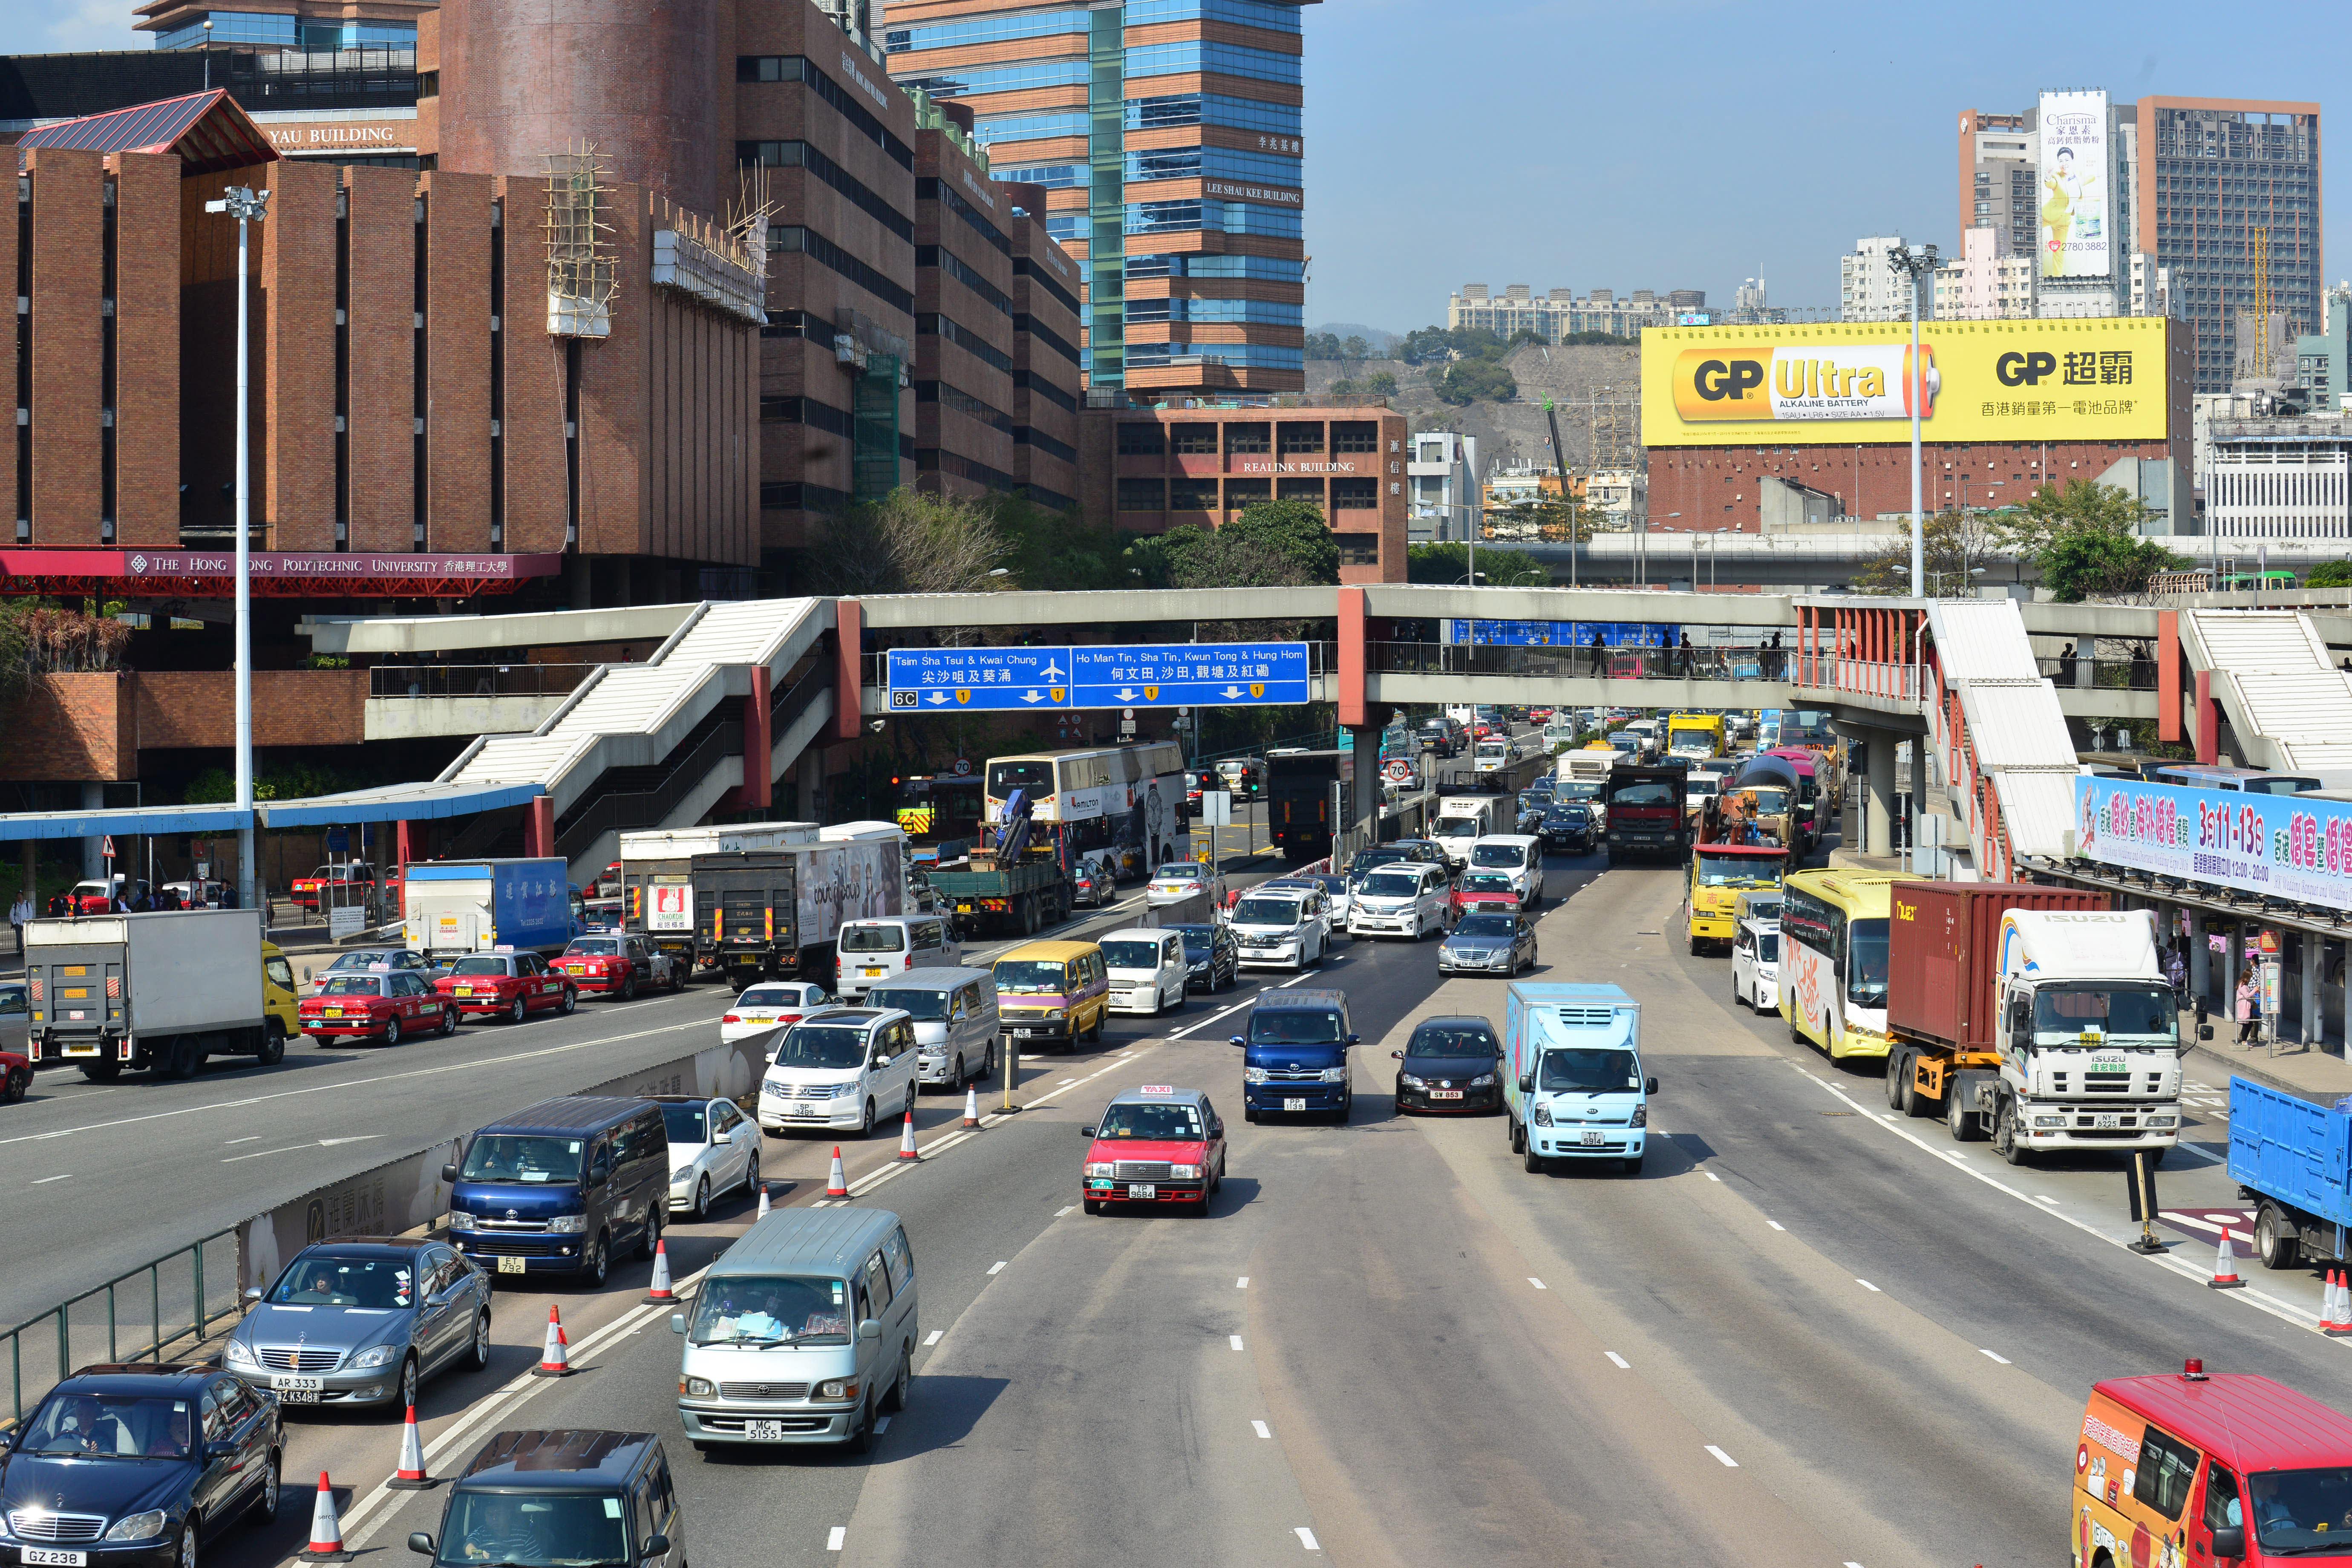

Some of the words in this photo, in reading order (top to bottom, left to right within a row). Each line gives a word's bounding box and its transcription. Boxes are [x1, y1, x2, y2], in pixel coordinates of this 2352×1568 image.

[2046, 114, 2096, 125] Charisma
[269, 130, 302, 143] YAU
[310, 128, 393, 142] BUILDING
[2056, 125, 2090, 135] 家恩素
[1259, 136, 1299, 153] 李兆基樓
[2048, 136, 2099, 145] 高鈣低脂奶粉
[1207, 183, 1222, 193] LEE
[1224, 185, 1245, 196] SHAU
[1246, 188, 1262, 198] KEE
[1263, 190, 1299, 203] BUILDING
[2061, 243, 2083, 251] 2780
[2085, 242, 2107, 250] 3882
[1680, 315, 1709, 325] cody
[1996, 352, 2056, 386] GP
[2063, 351, 2132, 385] 超霸
[1694, 360, 1764, 401] GP
[1776, 359, 1885, 398] Ultra
[1244, 463, 1295, 472] REALINK
[1300, 462, 1355, 472] BUILDING
[153, 558, 179, 570] THE
[190, 558, 226, 571] HONG
[248, 560, 273, 571] ONG
[283, 559, 362, 571] POLYTECHNIC
[372, 559, 438, 572] UNIVERSITY
[444, 561, 507, 573] 香港理工大學
[895, 657, 917, 666] Tsim
[921, 656, 940, 666] Sha
[944, 656, 964, 665] Tsui
[968, 656, 975, 664] &
[980, 656, 1002, 664] Kwai
[1007, 655, 1037, 666] Chung
[1076, 653, 1090, 663] Ho
[1094, 653, 1114, 663] Man
[1117, 653, 1136, 663] Tin,
[1141, 653, 1159, 662] Sha
[1162, 652, 1181, 663] Tin,
[1185, 651, 1211, 661] Kwun
[1213, 651, 1237, 662] Tong
[1253, 651, 1277, 661] Hung
[1281, 651, 1303, 659] Hom
[922, 669, 1011, 683] 尖沙咀及葵涌
[1055, 691, 1060, 700] 1
[1149, 689, 1153, 697] 1
[1254, 686, 1259, 695] 1
[895, 693, 915, 705] 6C
[960, 692, 965, 701] 1
[1391, 767, 1405, 775] 70
[1074, 799, 1098, 810] HAMILTON
[2154, 854, 2169, 869] Wedding
[2232, 861, 2247, 879] 12:00
[2252, 865, 2268, 882] 20:00
[814, 883, 832, 905] tout
[841, 882, 859, 904] coup
[1707, 893, 1718, 904] 志
[2091, 1063, 2126, 1072] 佳宏物流
[278, 1378, 290, 1387] AR
[295, 1379, 317, 1388] 333
[756, 1421, 771, 1430] MG
[750, 1430, 777, 1439] 5155
[2083, 1415, 2140, 1465] 定期保養消防系統
[2095, 1526, 2107, 1546] EXIT
[29, 1551, 46, 1562] GZ
[51, 1553, 78, 1564] 238
